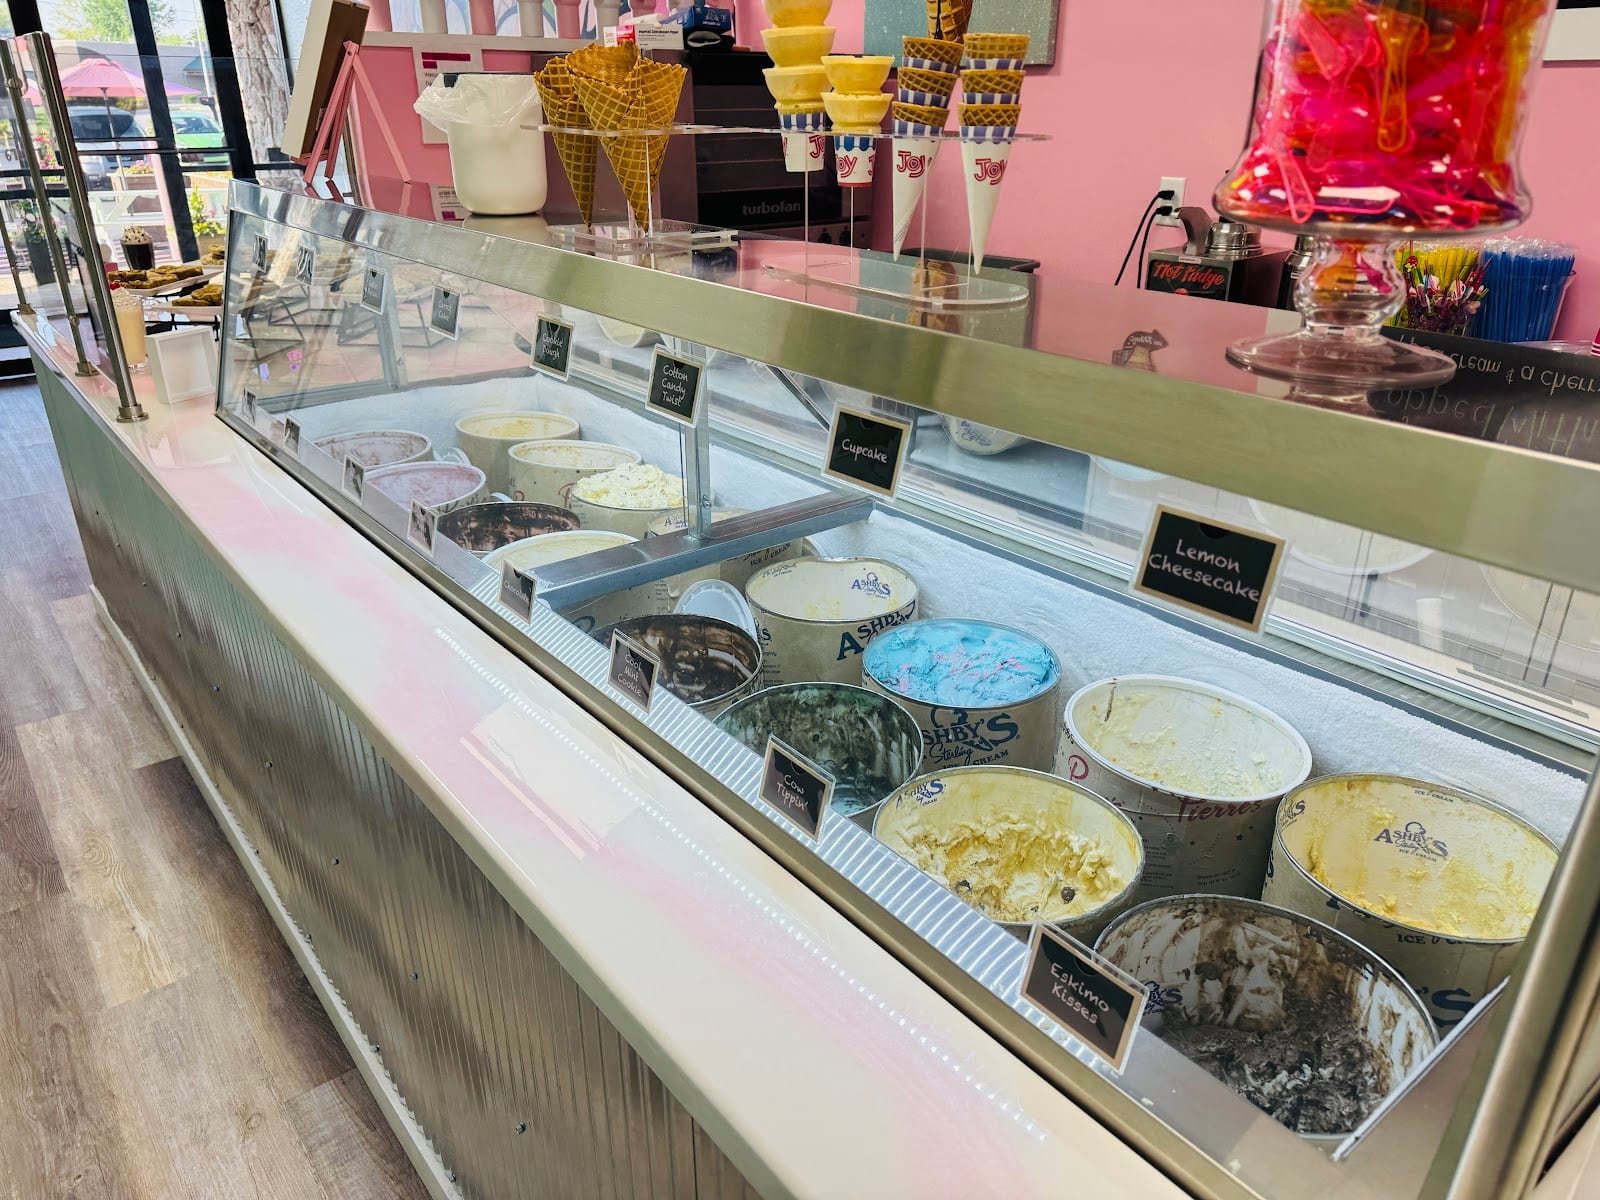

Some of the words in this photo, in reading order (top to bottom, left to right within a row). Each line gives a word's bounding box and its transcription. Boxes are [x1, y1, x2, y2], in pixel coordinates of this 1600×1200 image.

[896, 150, 933, 179] Joy
[974, 158, 1008, 186] Joy
[742, 200, 801, 216] turbofan
[1153, 262, 1184, 280] Hot
[1181, 265, 1225, 289] Fudge
[542, 333, 564, 348] Cookie
[663, 364, 689, 382] Cotton
[661, 379, 687, 400] Candy
[662, 390, 682, 407] Twist
[841, 438, 888, 464] Cupcake
[1175, 539, 1241, 574] Lemon
[1148, 553, 1260, 602] Cheesecake
[624, 654, 642, 671] Cool
[624, 666, 640, 682] Mint
[617, 673, 642, 698] Cookie
[921, 712, 1020, 748] SHBY'S
[929, 744, 974, 768] Sterling
[776, 782, 809, 811] Tippin'
[784, 774, 804, 795] Cow
[1374, 828, 1449, 859] ASHBY'S
[1397, 933, 1426, 945] ICE
[1050, 962, 1110, 1012] Eskimo
[1051, 982, 1099, 1024] Kisses
